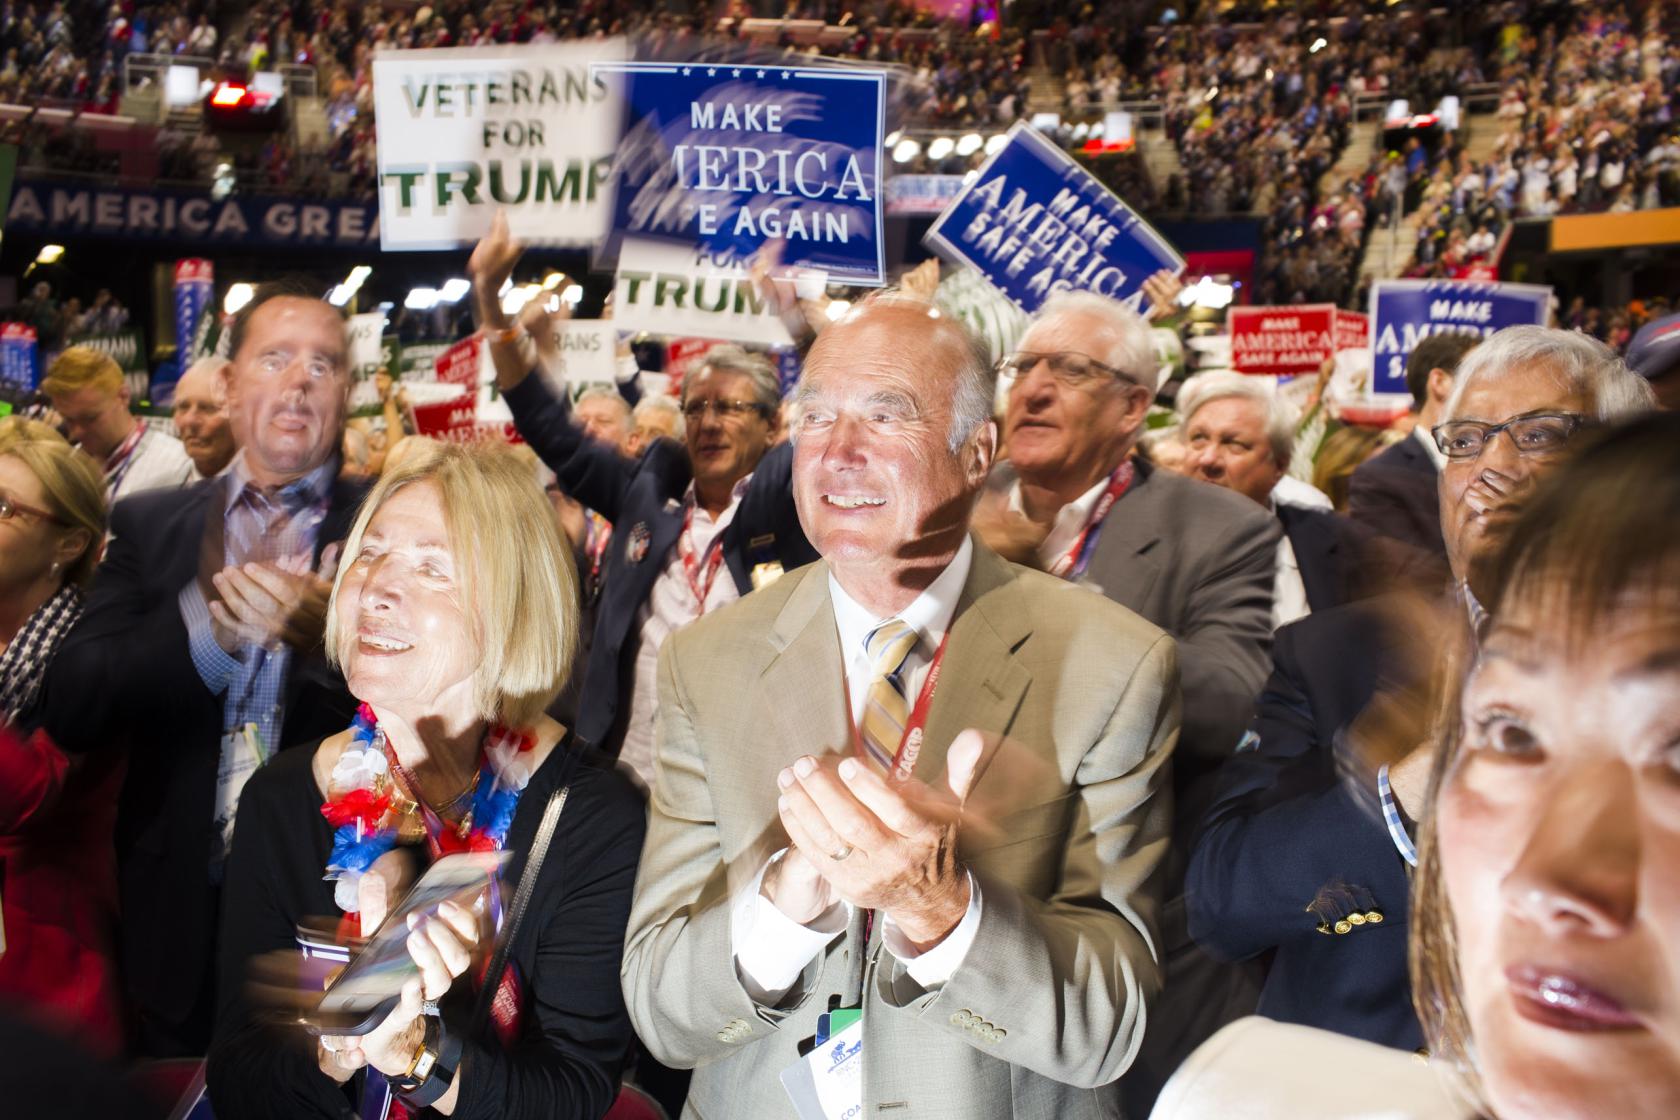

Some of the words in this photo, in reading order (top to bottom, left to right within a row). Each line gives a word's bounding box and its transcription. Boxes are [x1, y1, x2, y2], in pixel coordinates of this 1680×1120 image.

[401, 68, 608, 116] VETERANS
[482, 121, 546, 148] FOR
[690, 101, 782, 132] MAKE
[381, 160, 611, 212] TRUMP
[671, 145, 872, 201] ERICA
[8, 187, 249, 233] AMERICA
[265, 202, 380, 239] GRE
[733, 208, 849, 244] AGAIN
[1048, 187, 1121, 252] MAKE
[961, 212, 1036, 281] SAFE
[620, 270, 780, 317] TRUM
[1430, 299, 1493, 322] MAKE
[1233, 331, 1334, 350] AMERICA
[1261, 318, 1299, 331] MAKE
[1239, 352, 1275, 367] SAFE
[1278, 351, 1325, 365] AGAIN
